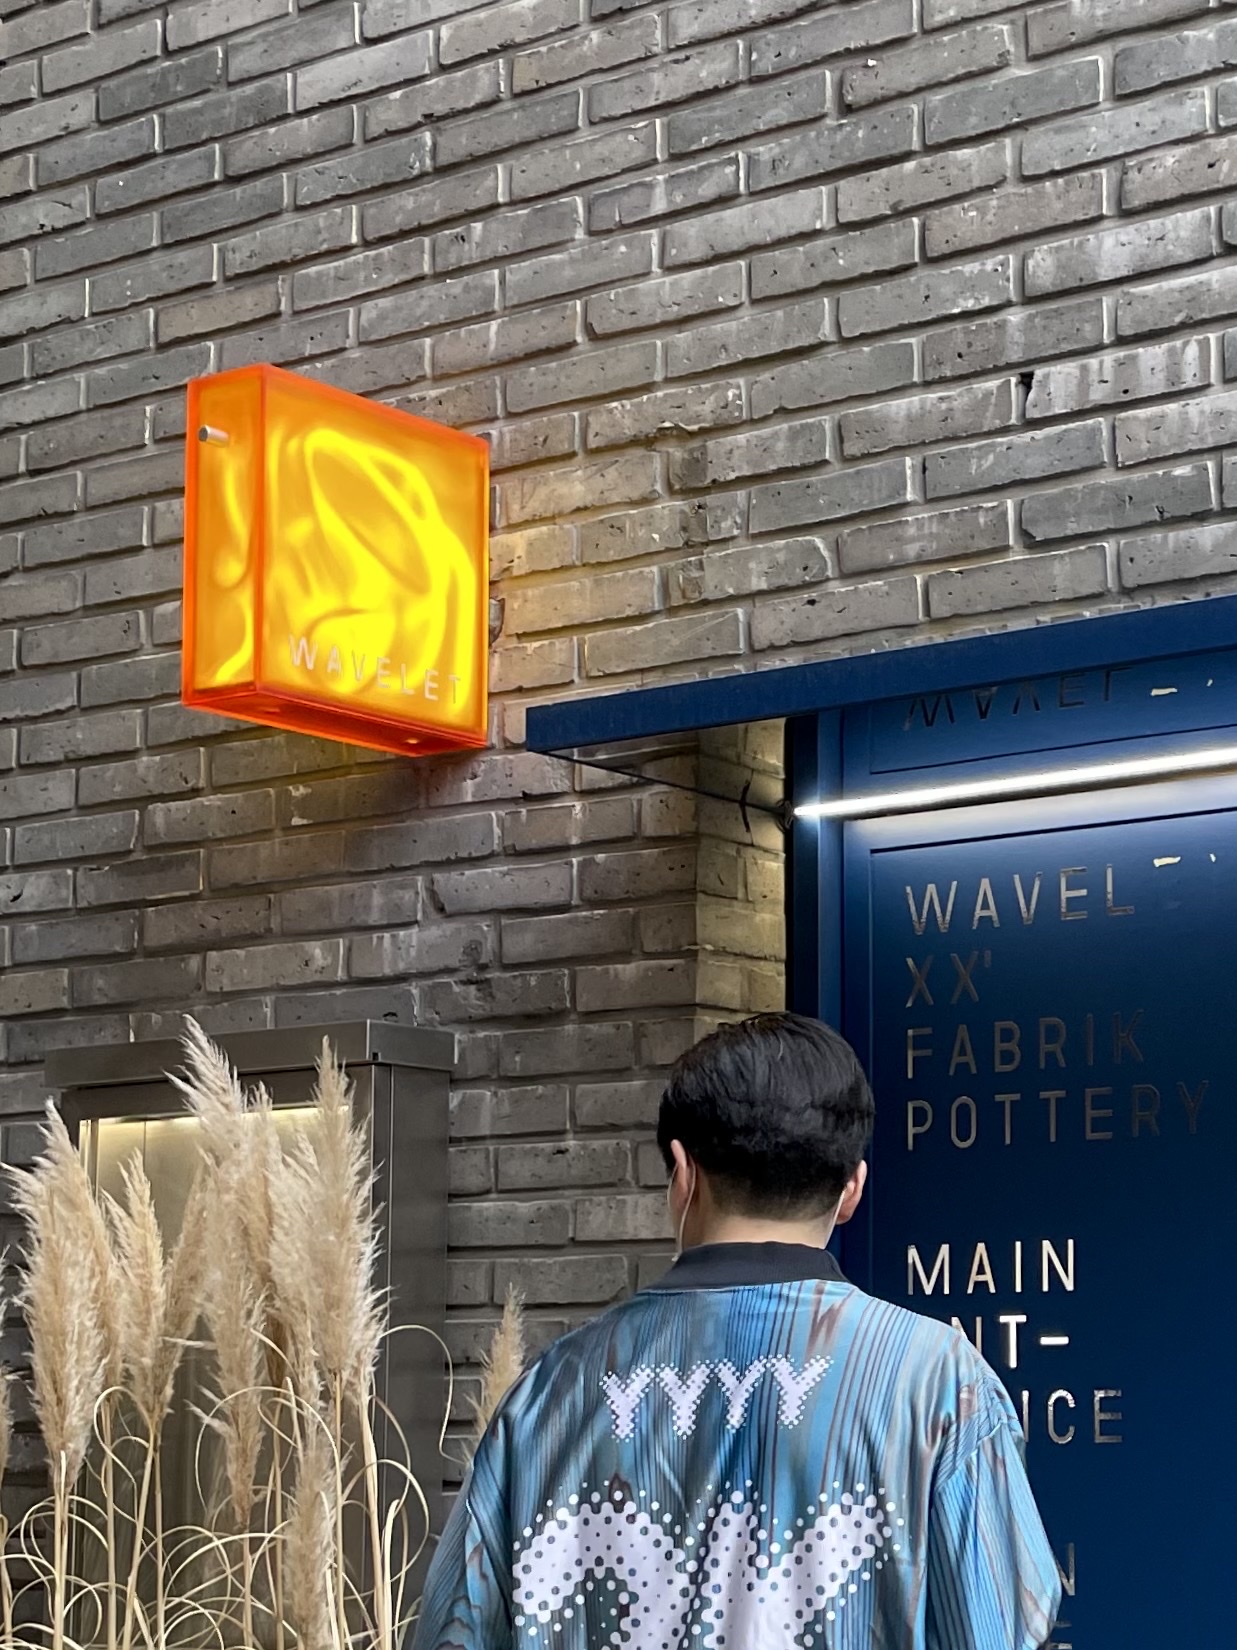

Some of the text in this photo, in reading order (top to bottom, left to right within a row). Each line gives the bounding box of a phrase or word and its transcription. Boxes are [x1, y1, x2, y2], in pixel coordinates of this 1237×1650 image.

[289, 634, 461, 704] WAVELET
[905, 854, 1216, 935] WAVEL
[906, 1009, 1145, 1080] FABRIK
[906, 1080, 1210, 1151] POTTERY
[907, 1238, 1075, 1296] MAIN
